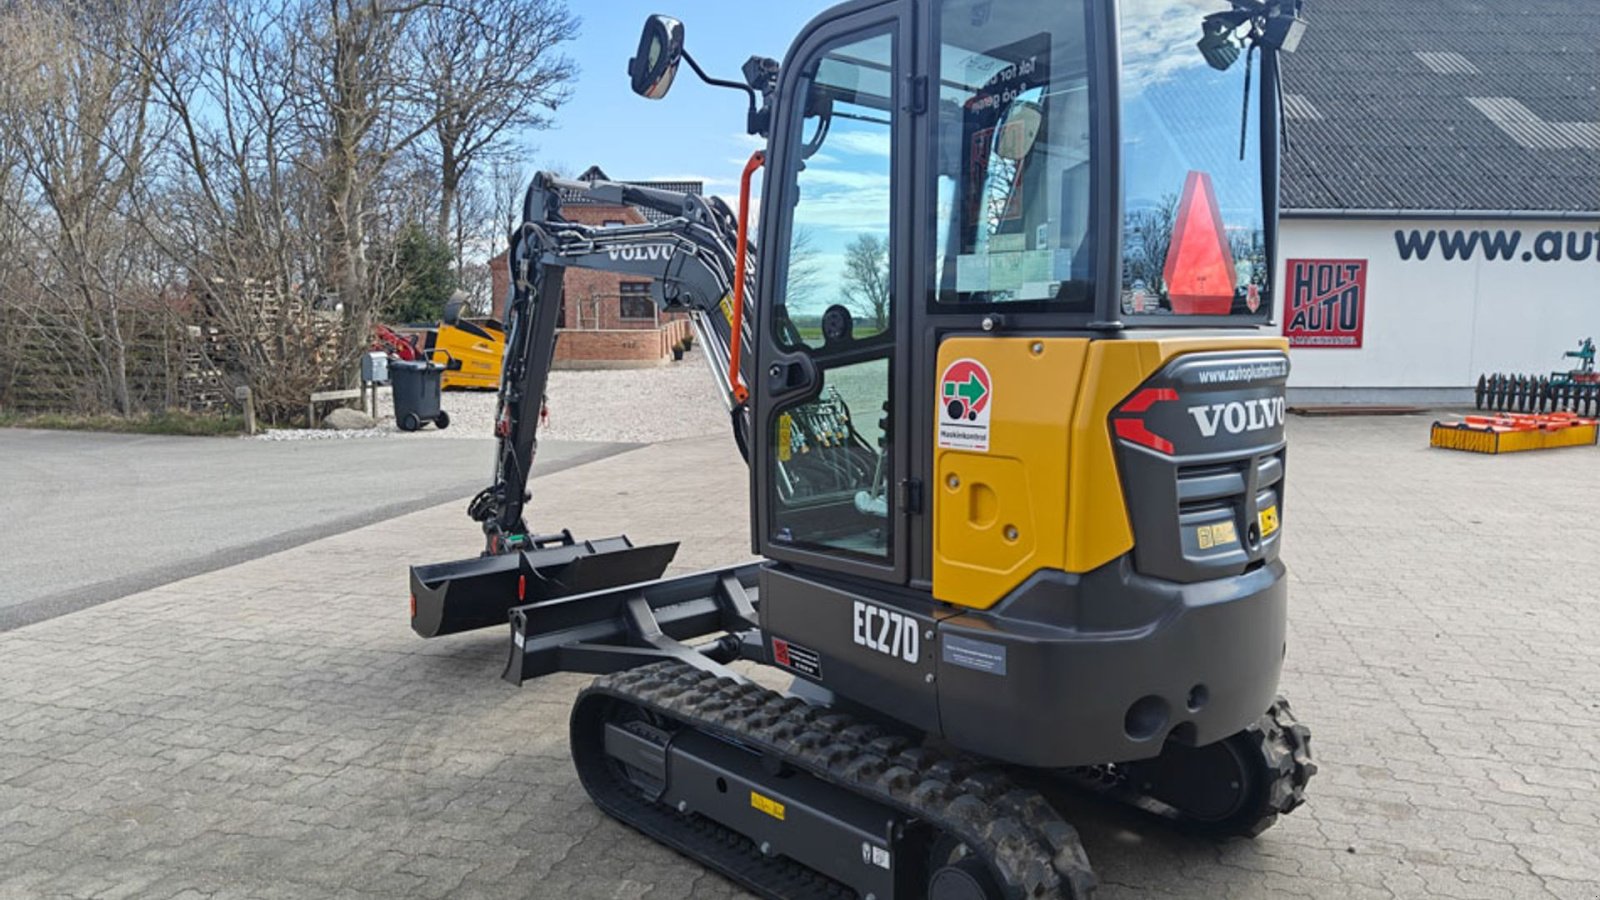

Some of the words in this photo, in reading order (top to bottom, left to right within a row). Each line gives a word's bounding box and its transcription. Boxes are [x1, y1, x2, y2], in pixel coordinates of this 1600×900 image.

[606, 244, 677, 261] VOLVO
[1289, 284, 1361, 332] AUTO
[1294, 264, 1362, 309] HOLT
[1188, 396, 1286, 437] VOLVO
[854, 600, 919, 664] EC27D
